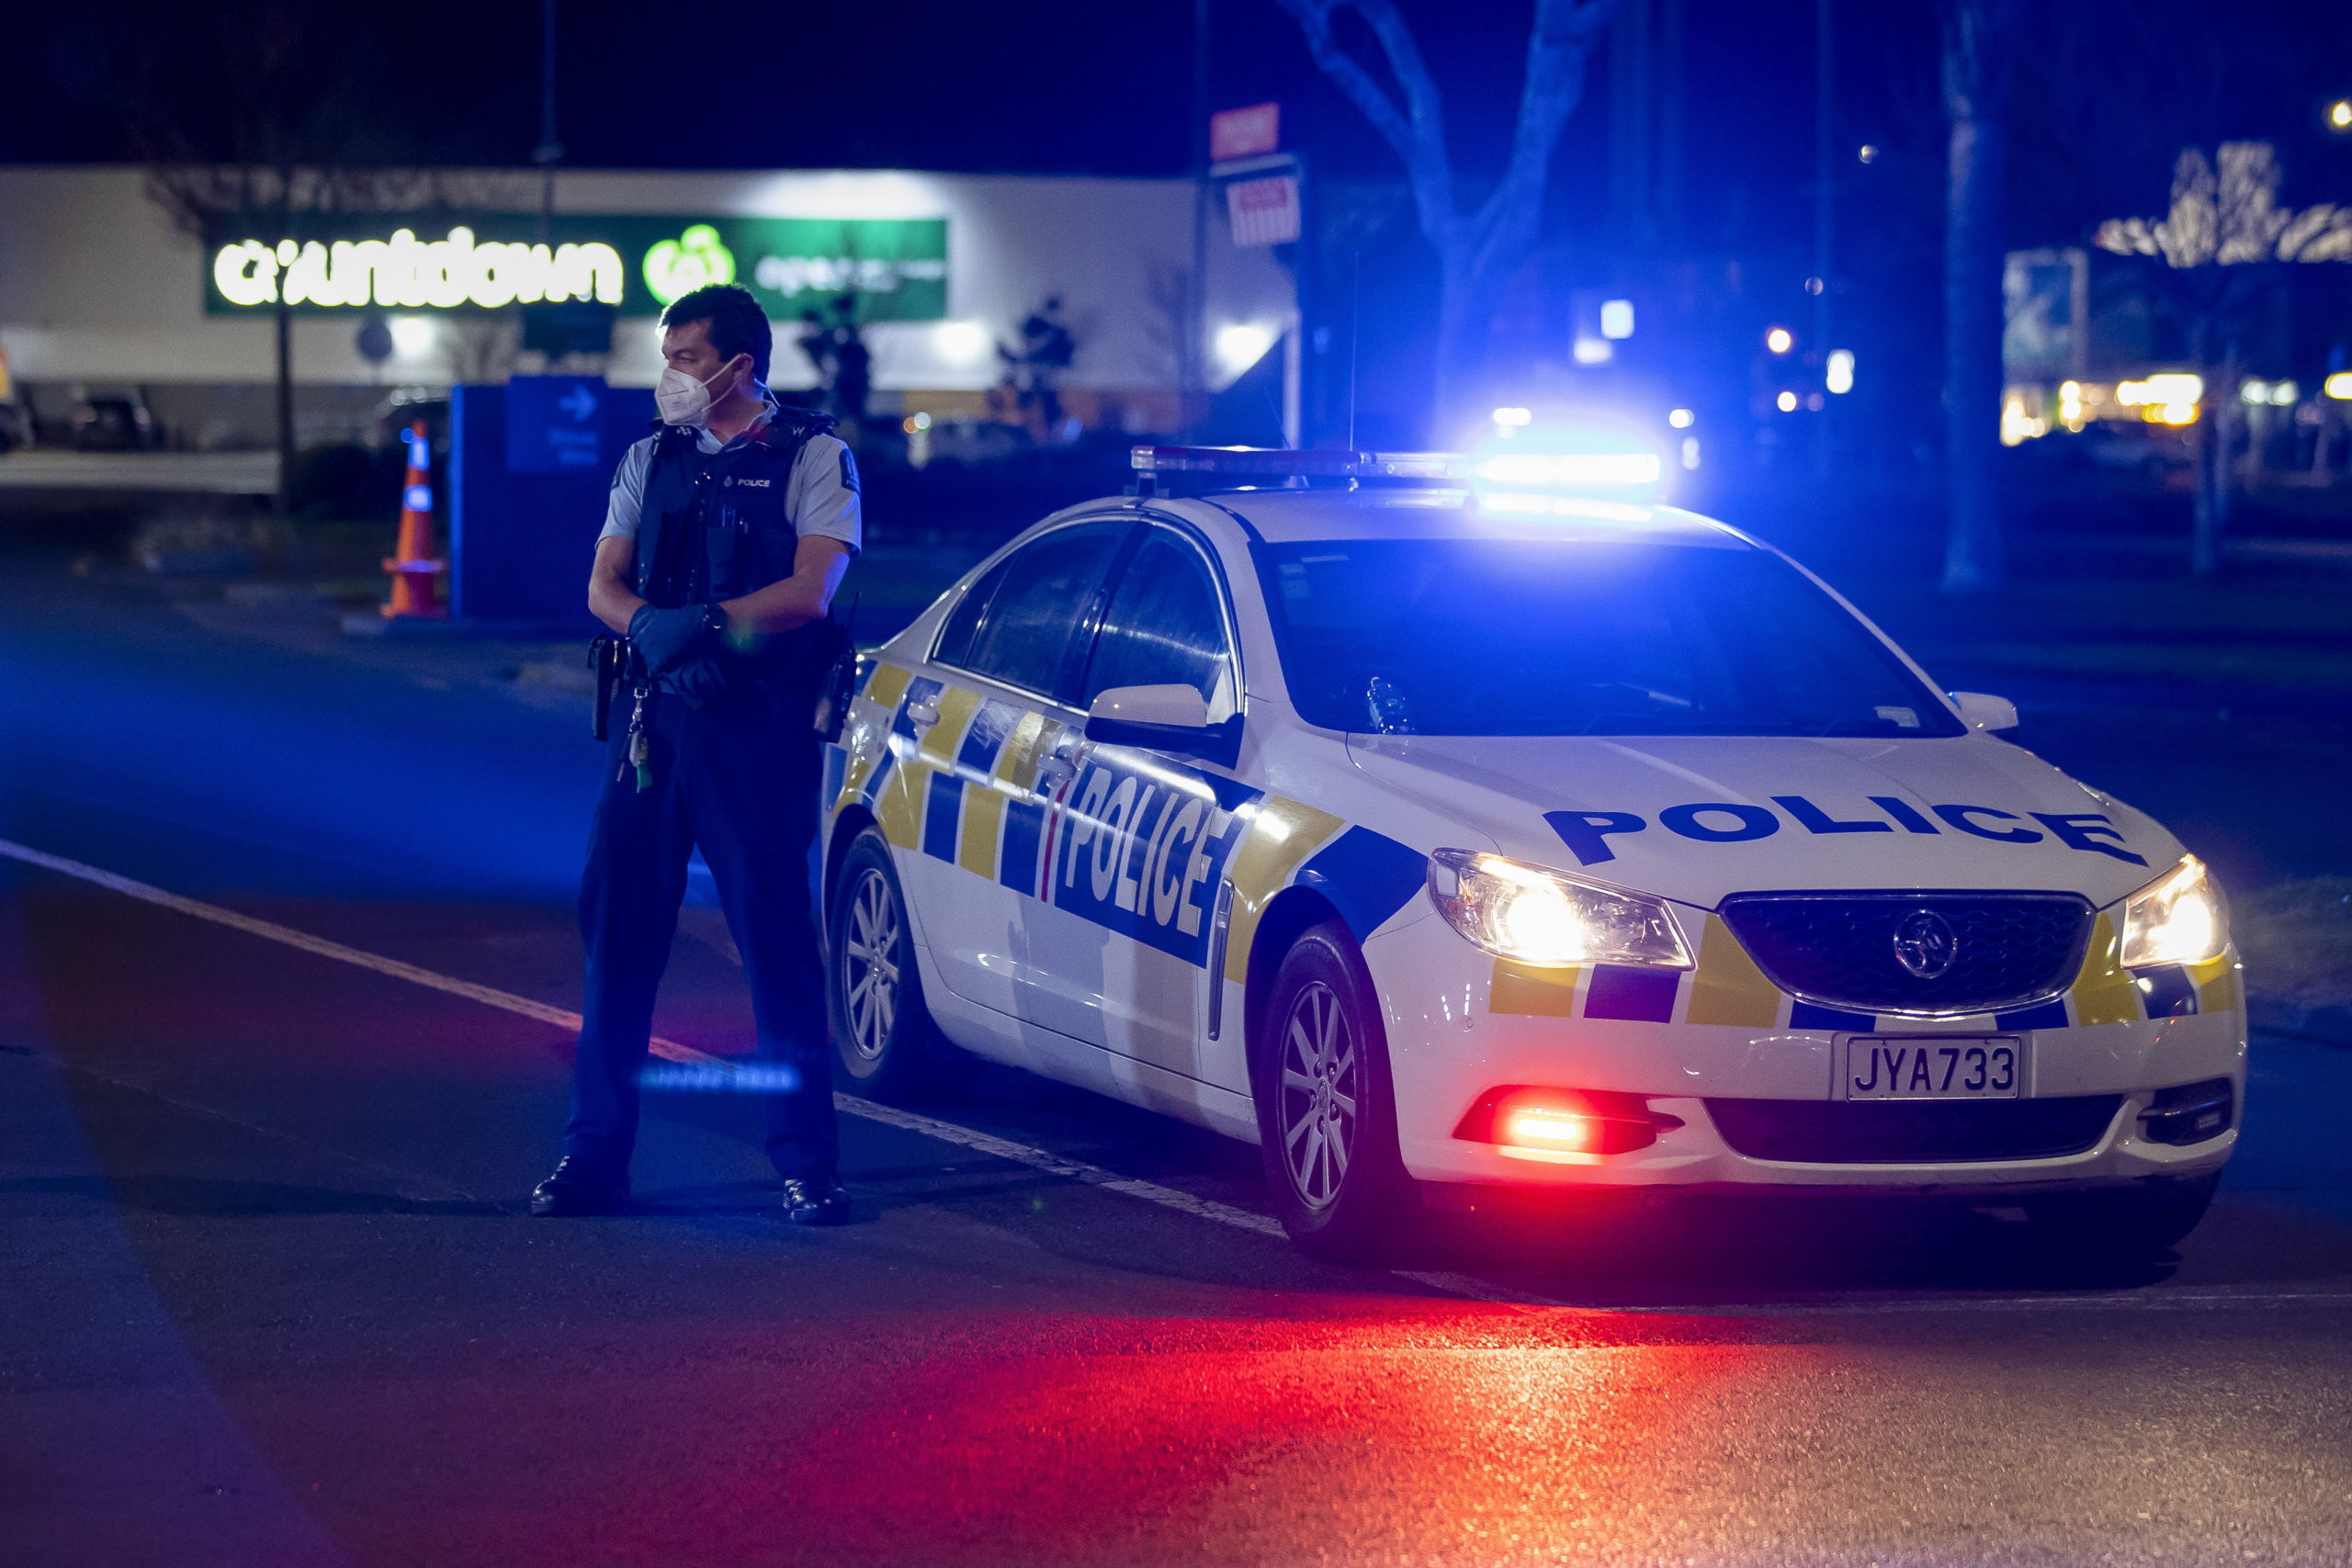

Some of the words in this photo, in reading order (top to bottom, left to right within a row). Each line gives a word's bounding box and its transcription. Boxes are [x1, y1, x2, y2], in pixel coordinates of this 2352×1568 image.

[738, 479, 770, 487] POLICE
[1066, 767, 1234, 937] POLICE
[1543, 795, 2149, 867] POLICE
[1854, 1047, 2014, 1091] JYA733
